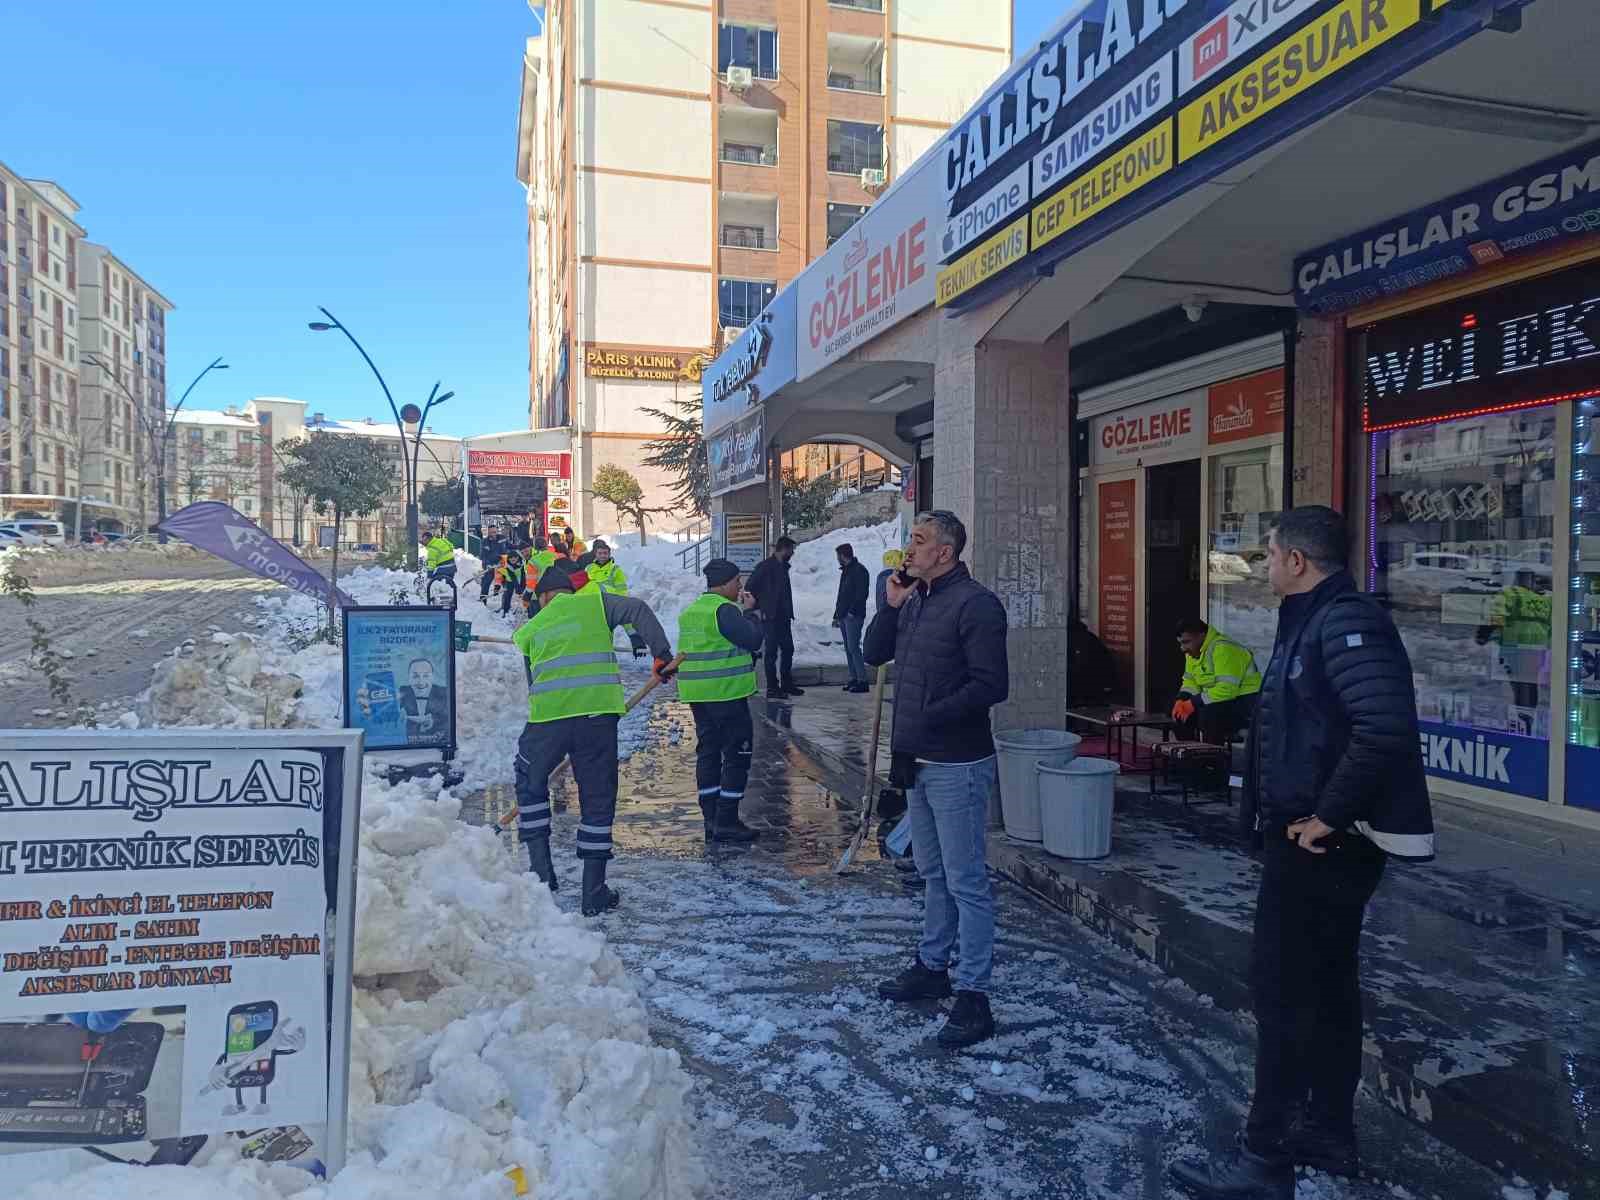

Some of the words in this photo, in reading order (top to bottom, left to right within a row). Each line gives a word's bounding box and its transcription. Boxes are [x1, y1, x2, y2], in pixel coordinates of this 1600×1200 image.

[1198, 0, 1388, 142] AKSESUAR
[1040, 71, 1161, 184] SAMSUNG
[1036, 200, 1065, 238] CEP
[1070, 132, 1166, 217] TELEFONU
[959, 184, 1020, 244] iPhone
[1299, 203, 1480, 295] ÇALIŞLAR
[1492, 156, 1600, 222] GSM
[981, 230, 1022, 276] SERVİS
[809, 218, 926, 349] GÖZLEME
[637, 369, 674, 380] SALONU
[1102, 408, 1191, 449] GÖZLEME
[371, 688, 392, 699] GEL
[0, 759, 323, 823] ALIŞLAR
[21, 830, 191, 874] TEKNİK
[194, 829, 320, 869] SERVİS
[0, 901, 43, 920] FIR
[47, 900, 66, 918] &
[69, 892, 142, 917] İKİNCİ
[144, 895, 174, 913] EL
[178, 891, 273, 912] TELEFON
[3, 944, 109, 973] DEĞİŞİMİ
[125, 941, 226, 964] ENTEGRE
[229, 933, 320, 961] DEĞİŞİMİ
[60, 922, 118, 943] ALIM
[134, 918, 200, 939] SATIM
[19, 971, 136, 996] AKSESUAR
[139, 964, 232, 988] DÜNYASI
